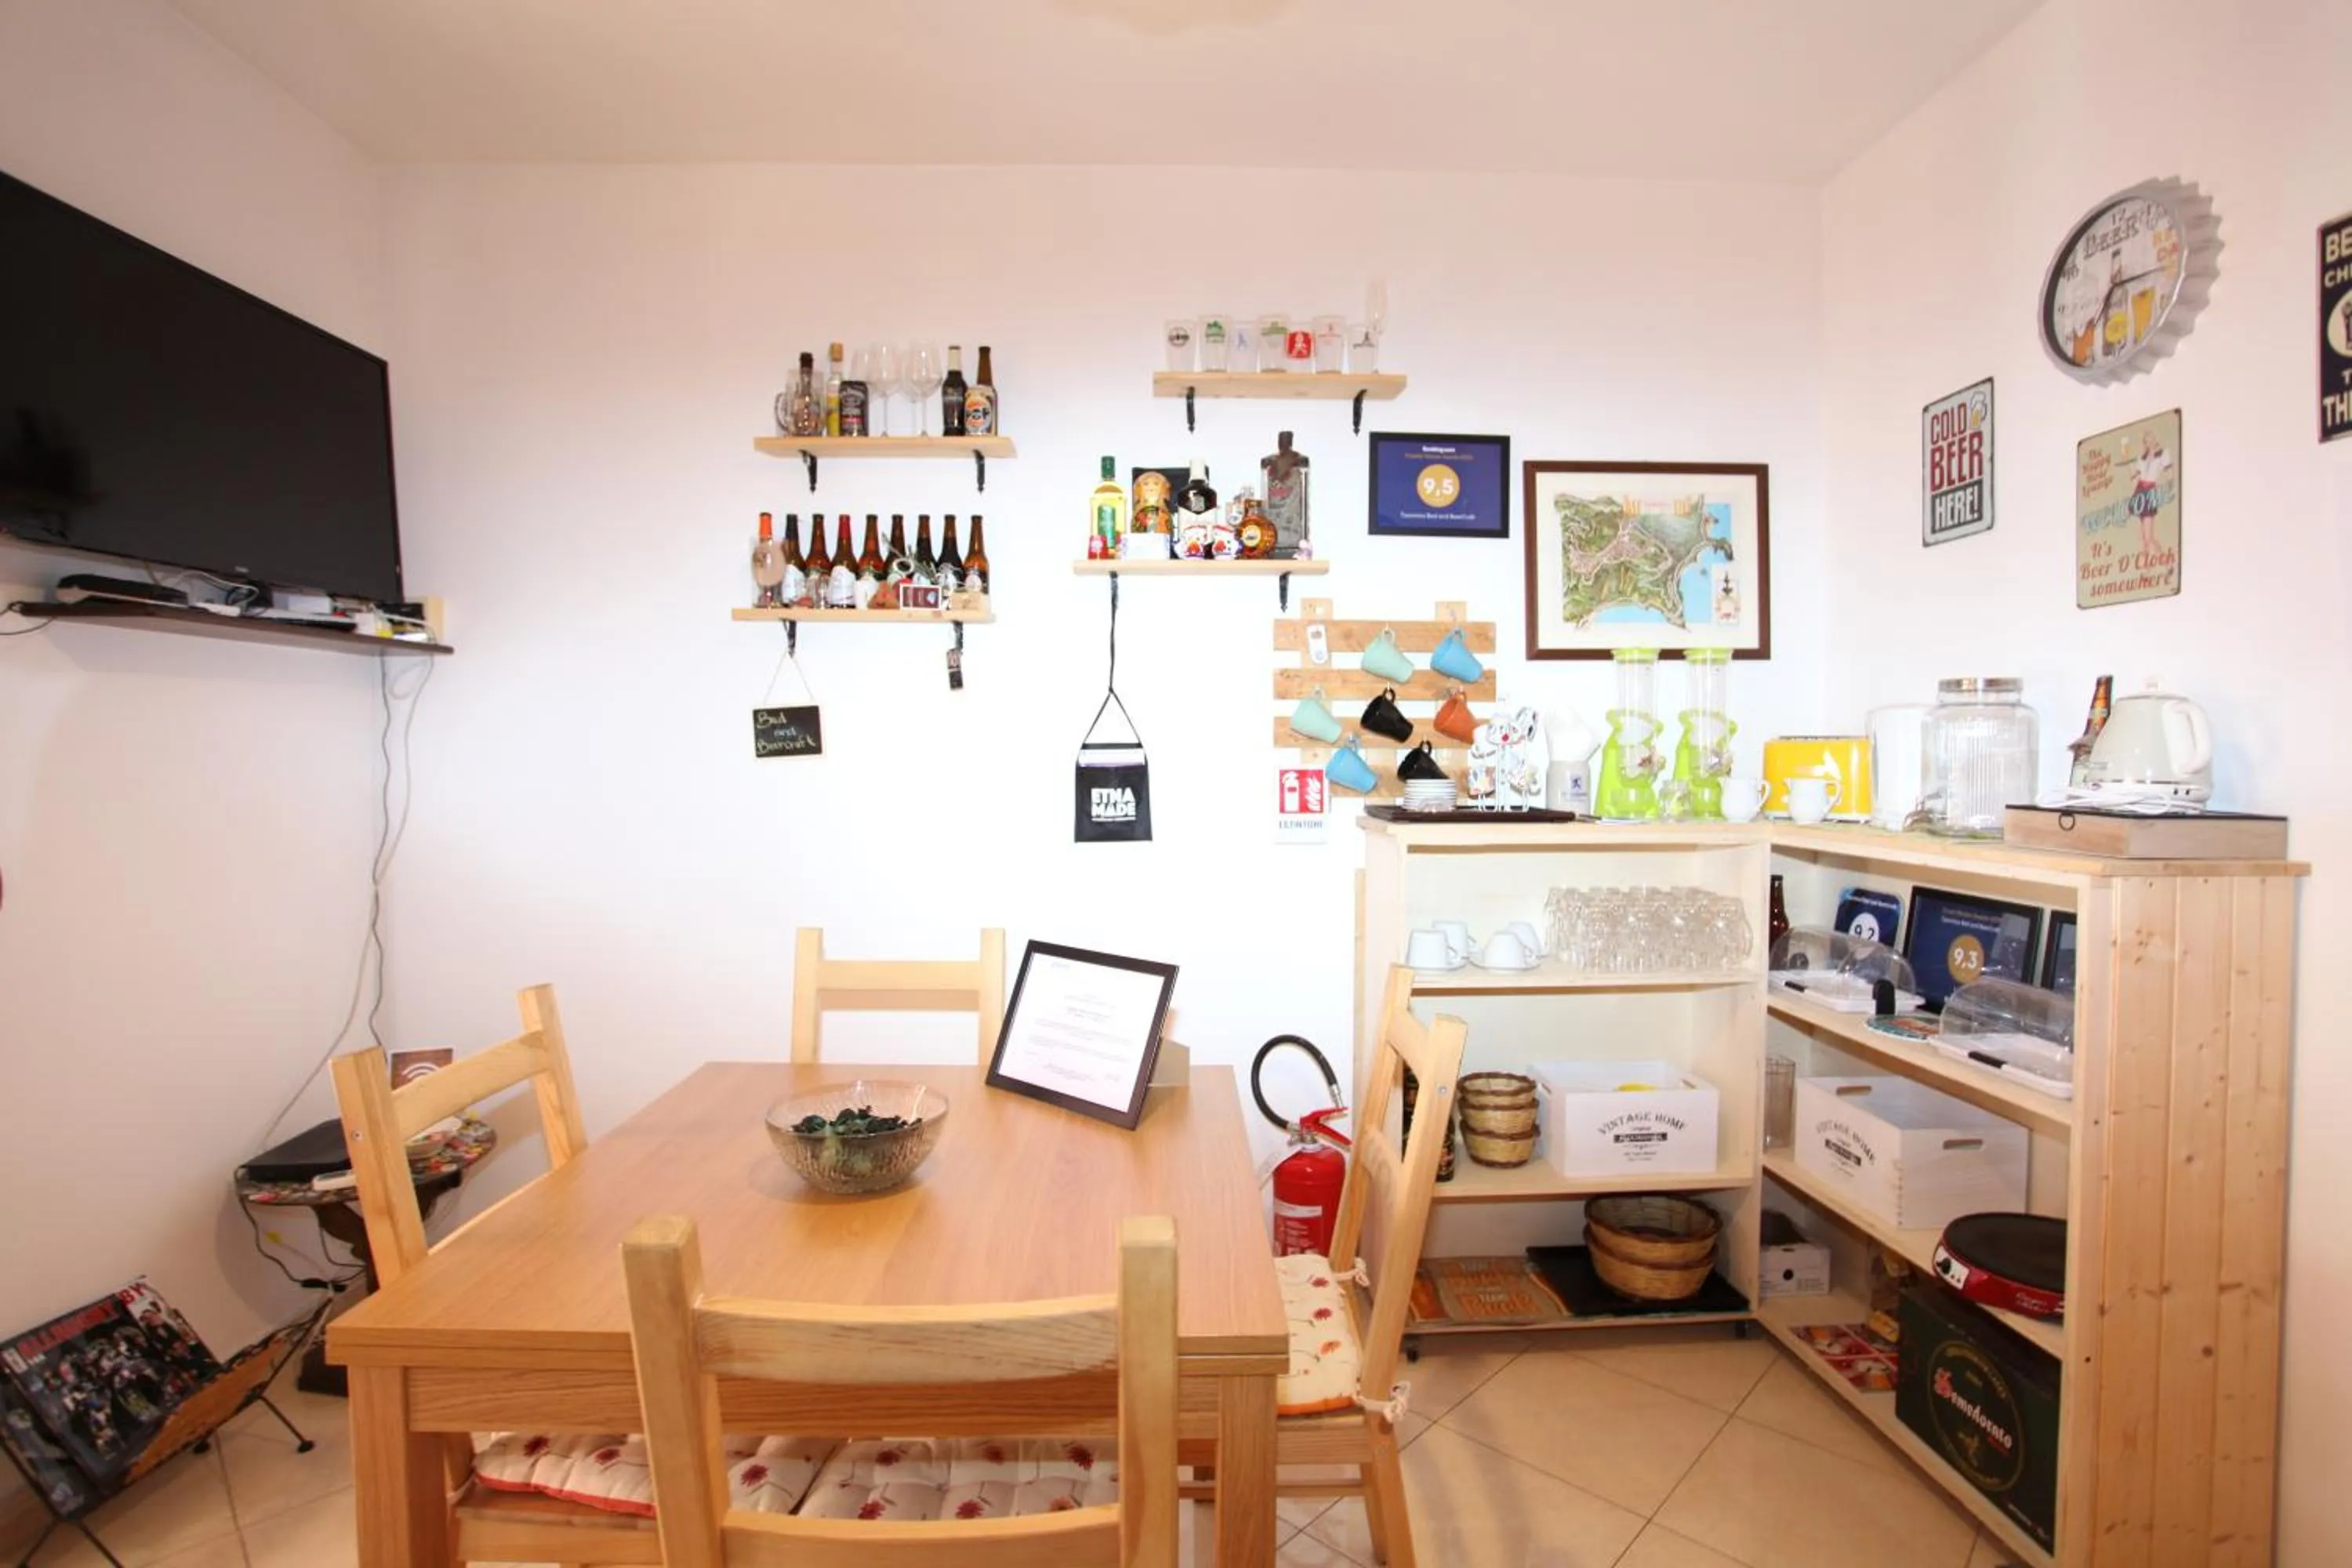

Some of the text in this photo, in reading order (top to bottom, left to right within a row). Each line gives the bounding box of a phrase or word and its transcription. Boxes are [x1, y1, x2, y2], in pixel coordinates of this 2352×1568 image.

[1931, 401, 1967, 445] COLD
[1930, 431, 1984, 493] BEER
[1423, 477, 1454, 497] 9,5
[1935, 485, 1979, 531] HERE!
[2090, 540, 2111, 559] It's
[2080, 547, 2176, 580] Beer O'Clock
[2090, 574, 2172, 597] somewhere
[1091, 787, 1135, 804] ETNA
[1091, 802, 1136, 818] MADE
[1955, 947, 1978, 969] 9,3
[1597, 1112, 1686, 1135] VINTAGE HOME
